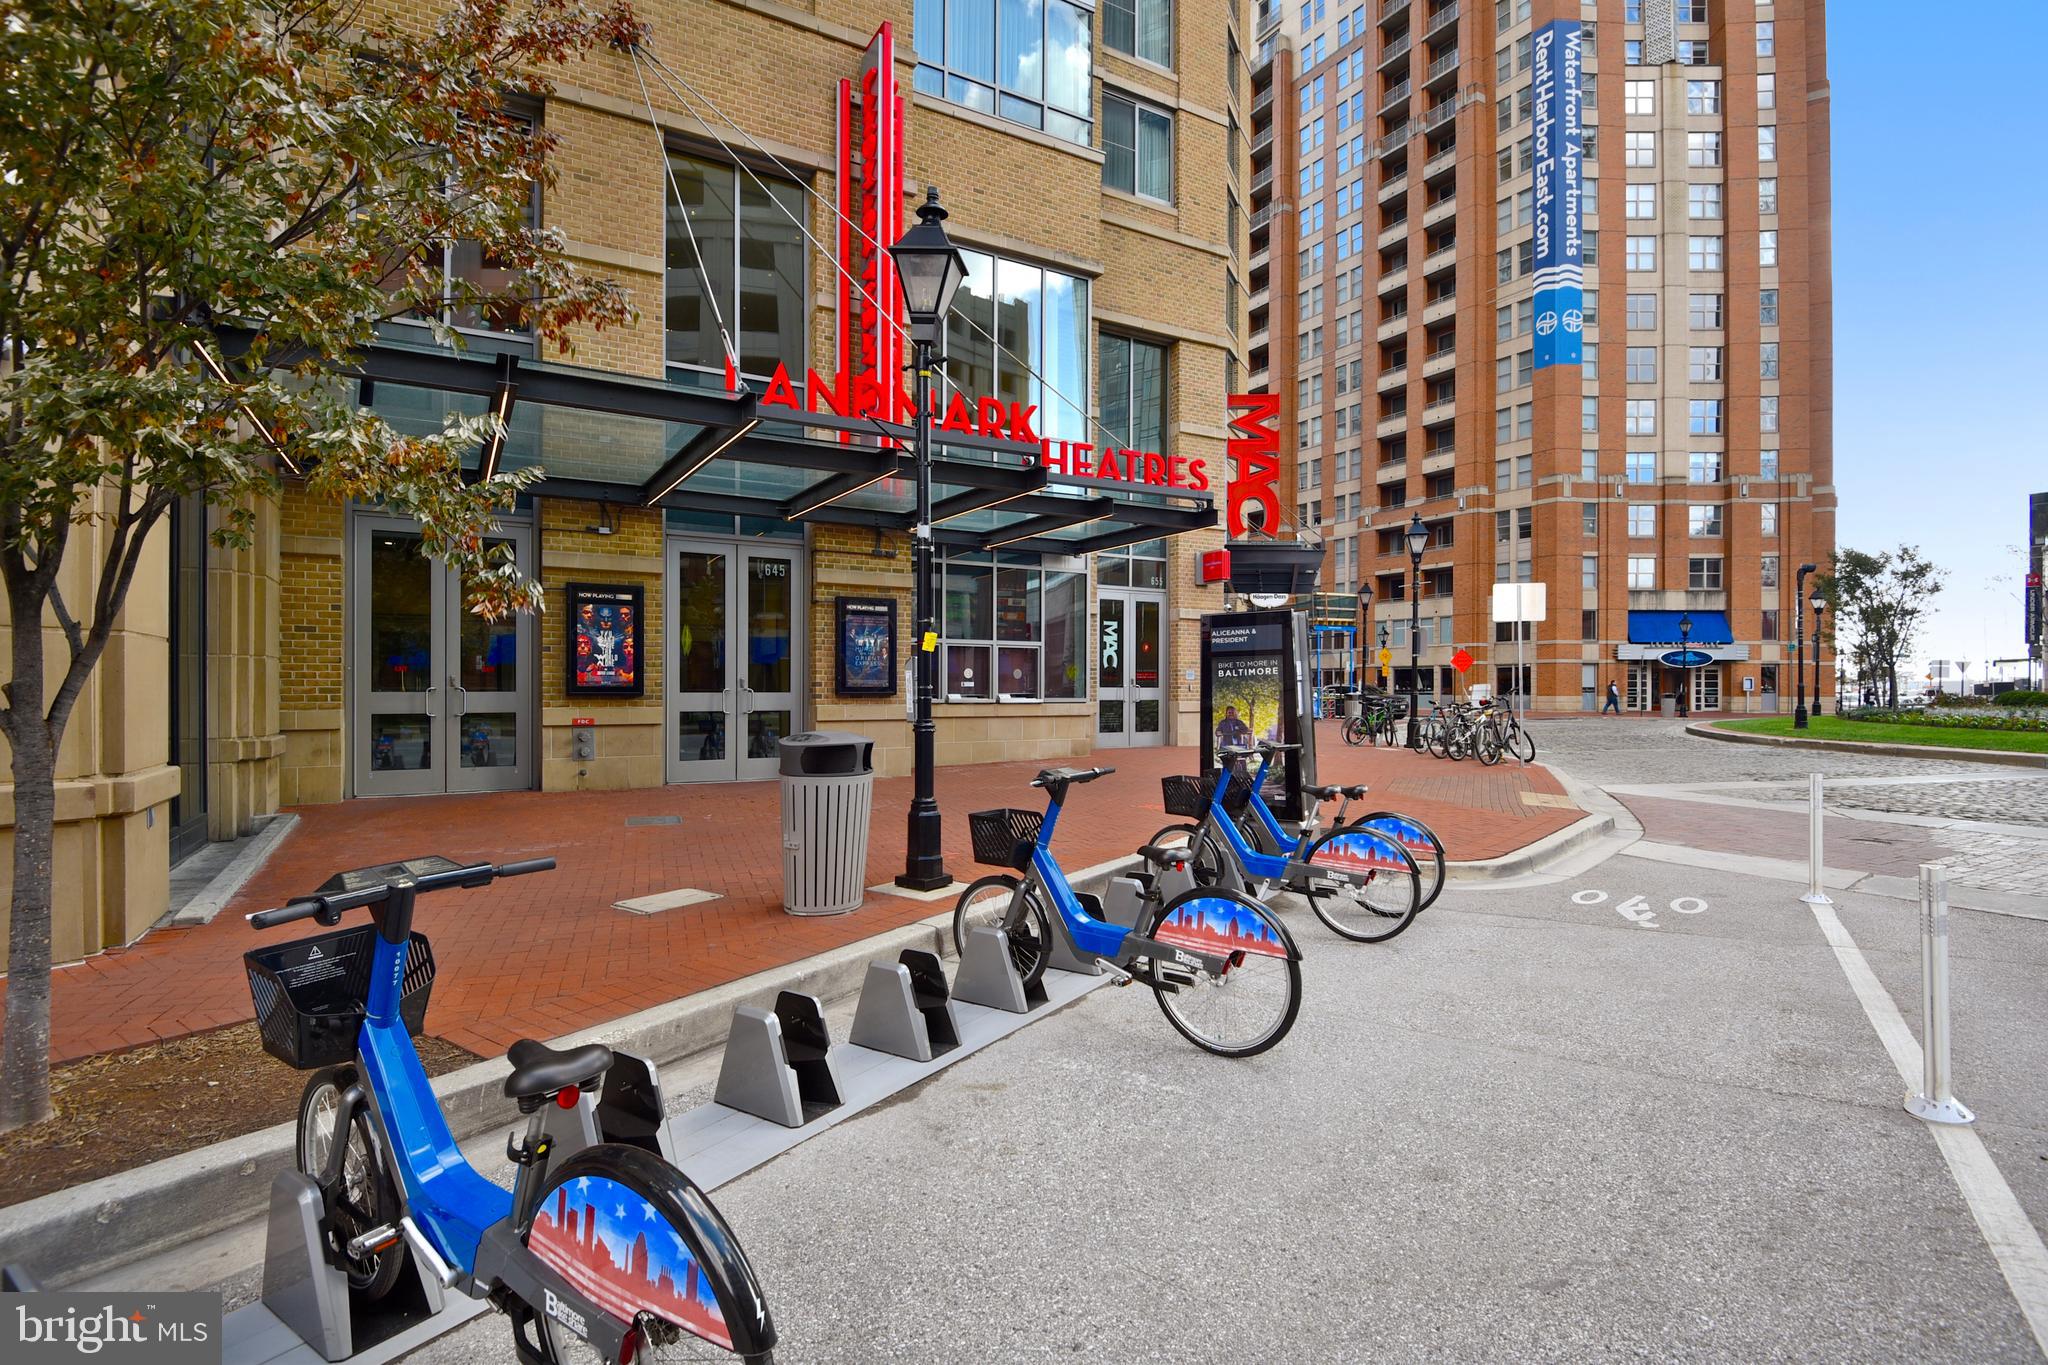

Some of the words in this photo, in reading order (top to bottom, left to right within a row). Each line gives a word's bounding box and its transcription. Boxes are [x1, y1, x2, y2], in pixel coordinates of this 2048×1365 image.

[1565, 30, 1582, 136] Waterfront
[1561, 142, 1582, 257] Apartments
[1041, 437, 1209, 491] HEATRES
[1227, 392, 1280, 539] MAC
[765, 563, 785, 577] 645
[1103, 620, 1118, 669] MAC
[1211, 628, 1251, 637] ALICEANNA
[1251, 627, 1257, 635] &
[1211, 636, 1248, 644] PRESIDENT
[1218, 667, 1279, 678] BALTIMORE
[392, 951, 401, 986] 10077
